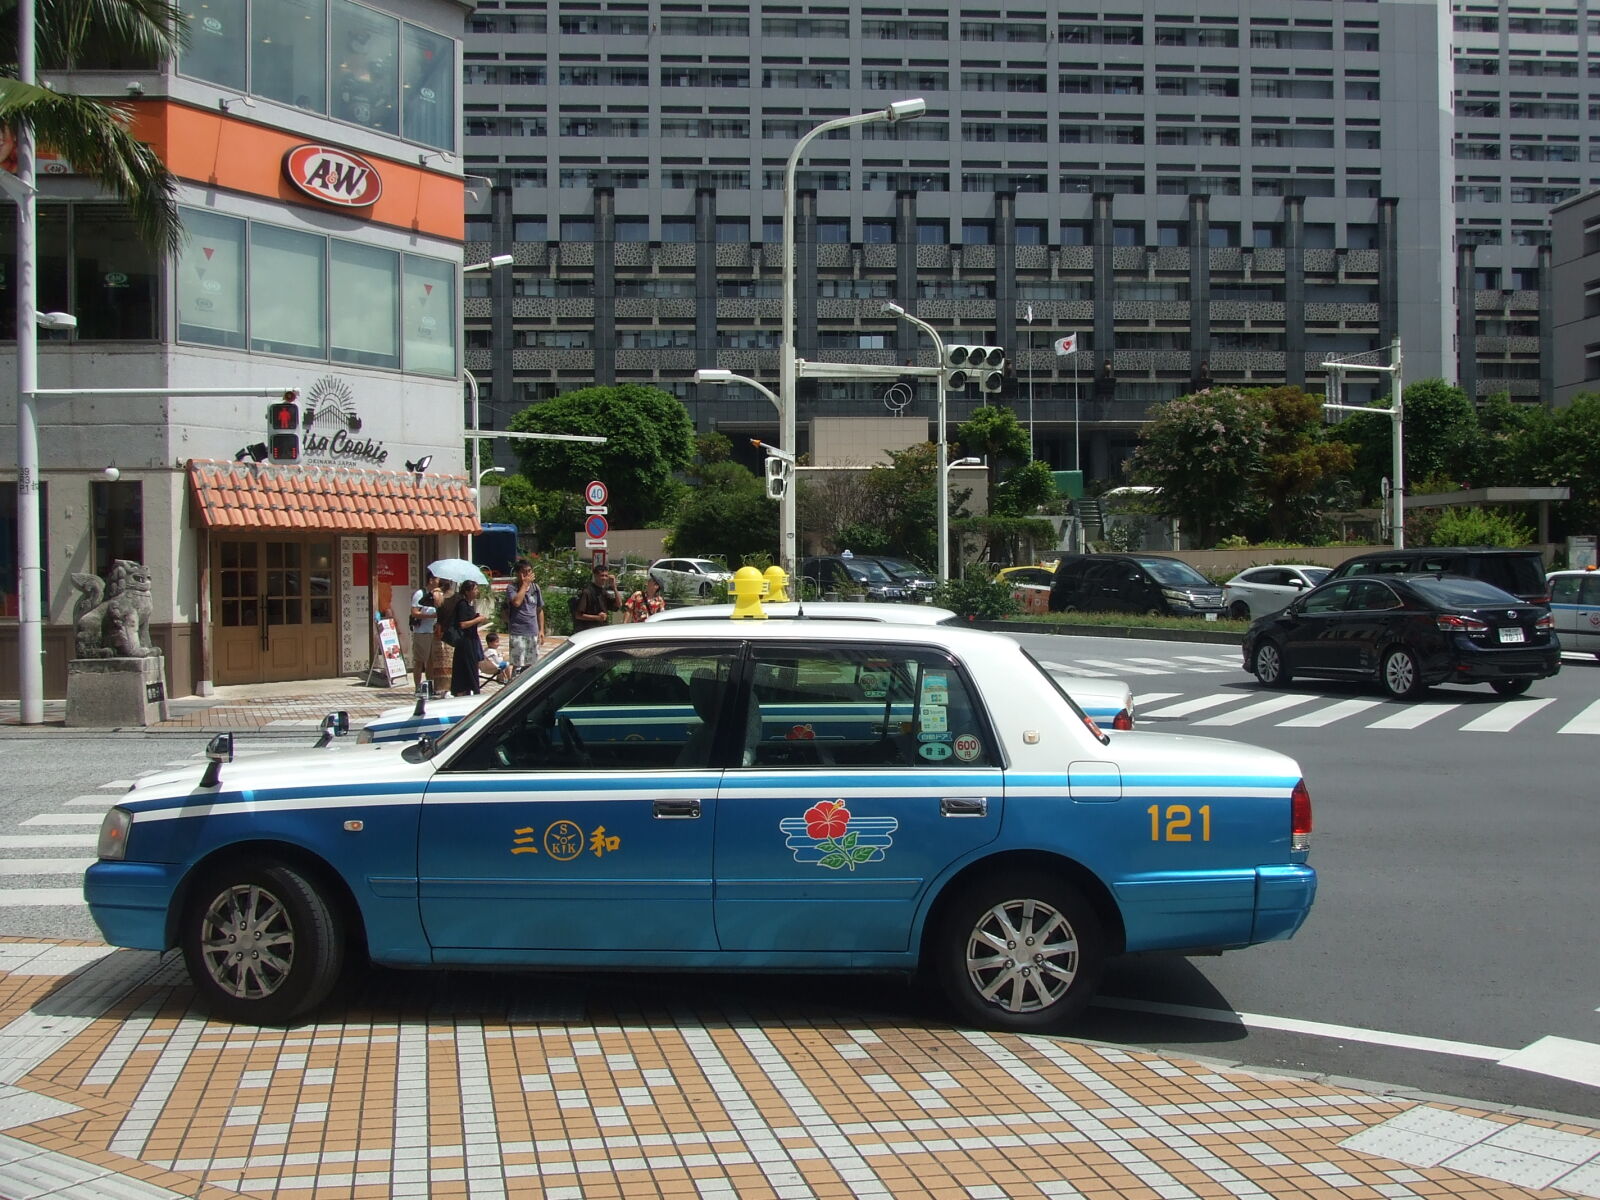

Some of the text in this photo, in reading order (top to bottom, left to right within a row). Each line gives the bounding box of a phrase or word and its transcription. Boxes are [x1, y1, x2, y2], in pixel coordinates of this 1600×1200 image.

[305, 158, 368, 196] A&W
[303, 429, 388, 463] isa Cookie
[591, 488, 603, 499] 40
[957, 740, 977, 751] 600
[1147, 804, 1210, 841] 121
